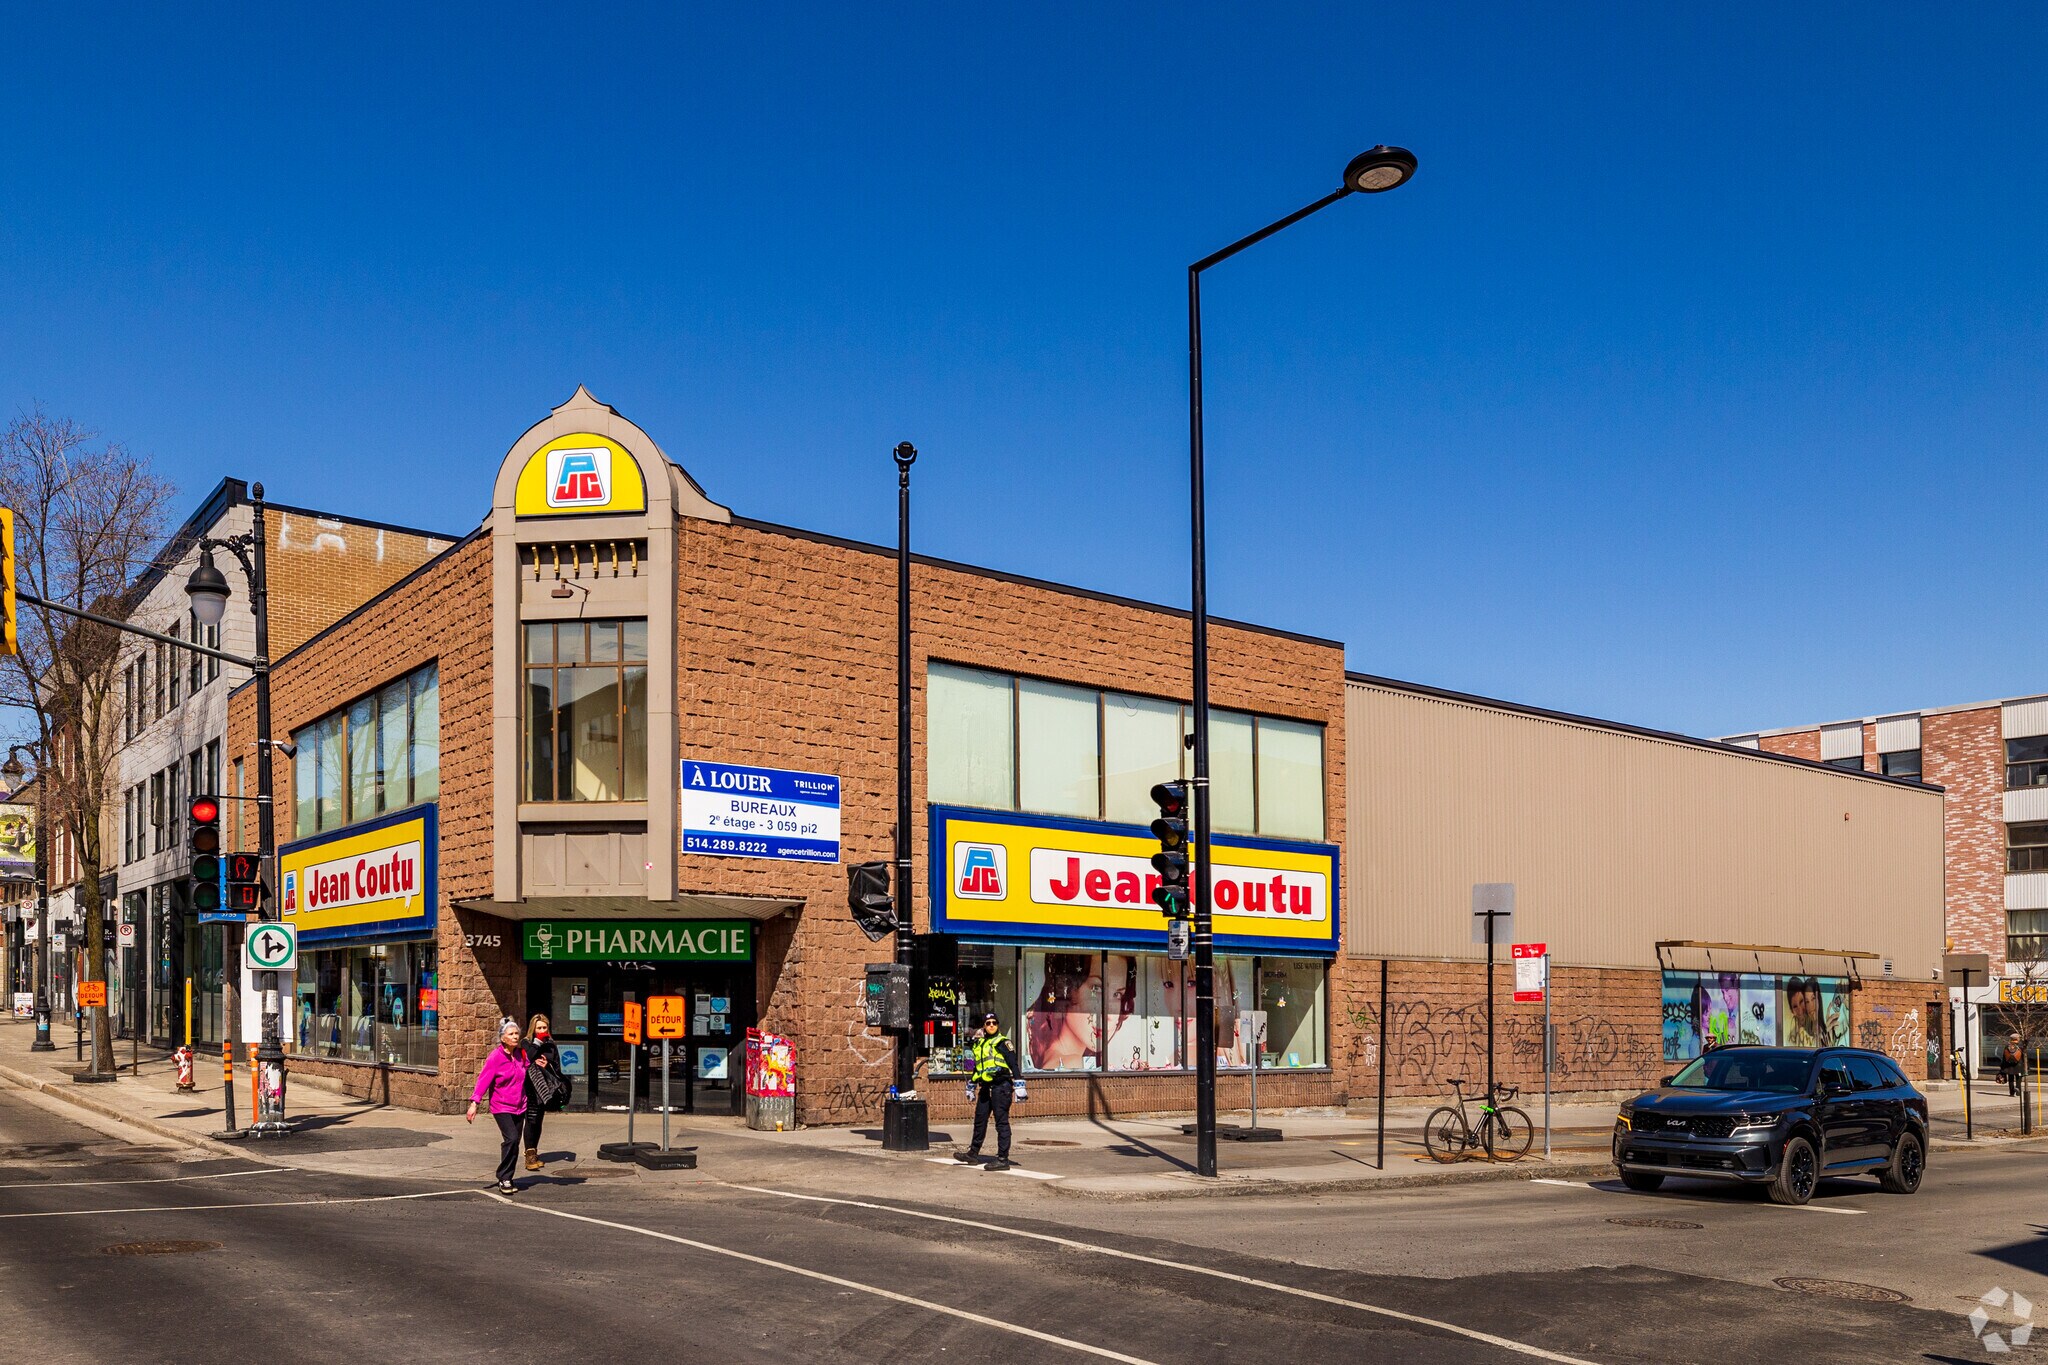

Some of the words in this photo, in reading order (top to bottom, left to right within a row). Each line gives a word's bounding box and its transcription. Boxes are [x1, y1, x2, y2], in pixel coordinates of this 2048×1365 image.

[691, 765, 706, 786] À
[710, 770, 772, 793] LOUER
[794, 780, 833, 791] TRILLION
[731, 800, 797, 817] BUREAUX
[723, 816, 755, 831] étage
[767, 819, 773, 830] 3
[777, 820, 797, 832] 059
[801, 823, 817, 835] pi2
[687, 837, 767, 853] 514.289.8222
[777, 847, 836, 858] agencetrillion.com
[309, 870, 350, 908] Jean
[355, 851, 413, 898] Coutu
[1189, 869, 1312, 915] outu
[465, 934, 501, 947] 3745
[567, 929, 745, 954] PHARMACIE
[651, 1015, 681, 1024] DÉTOUR
